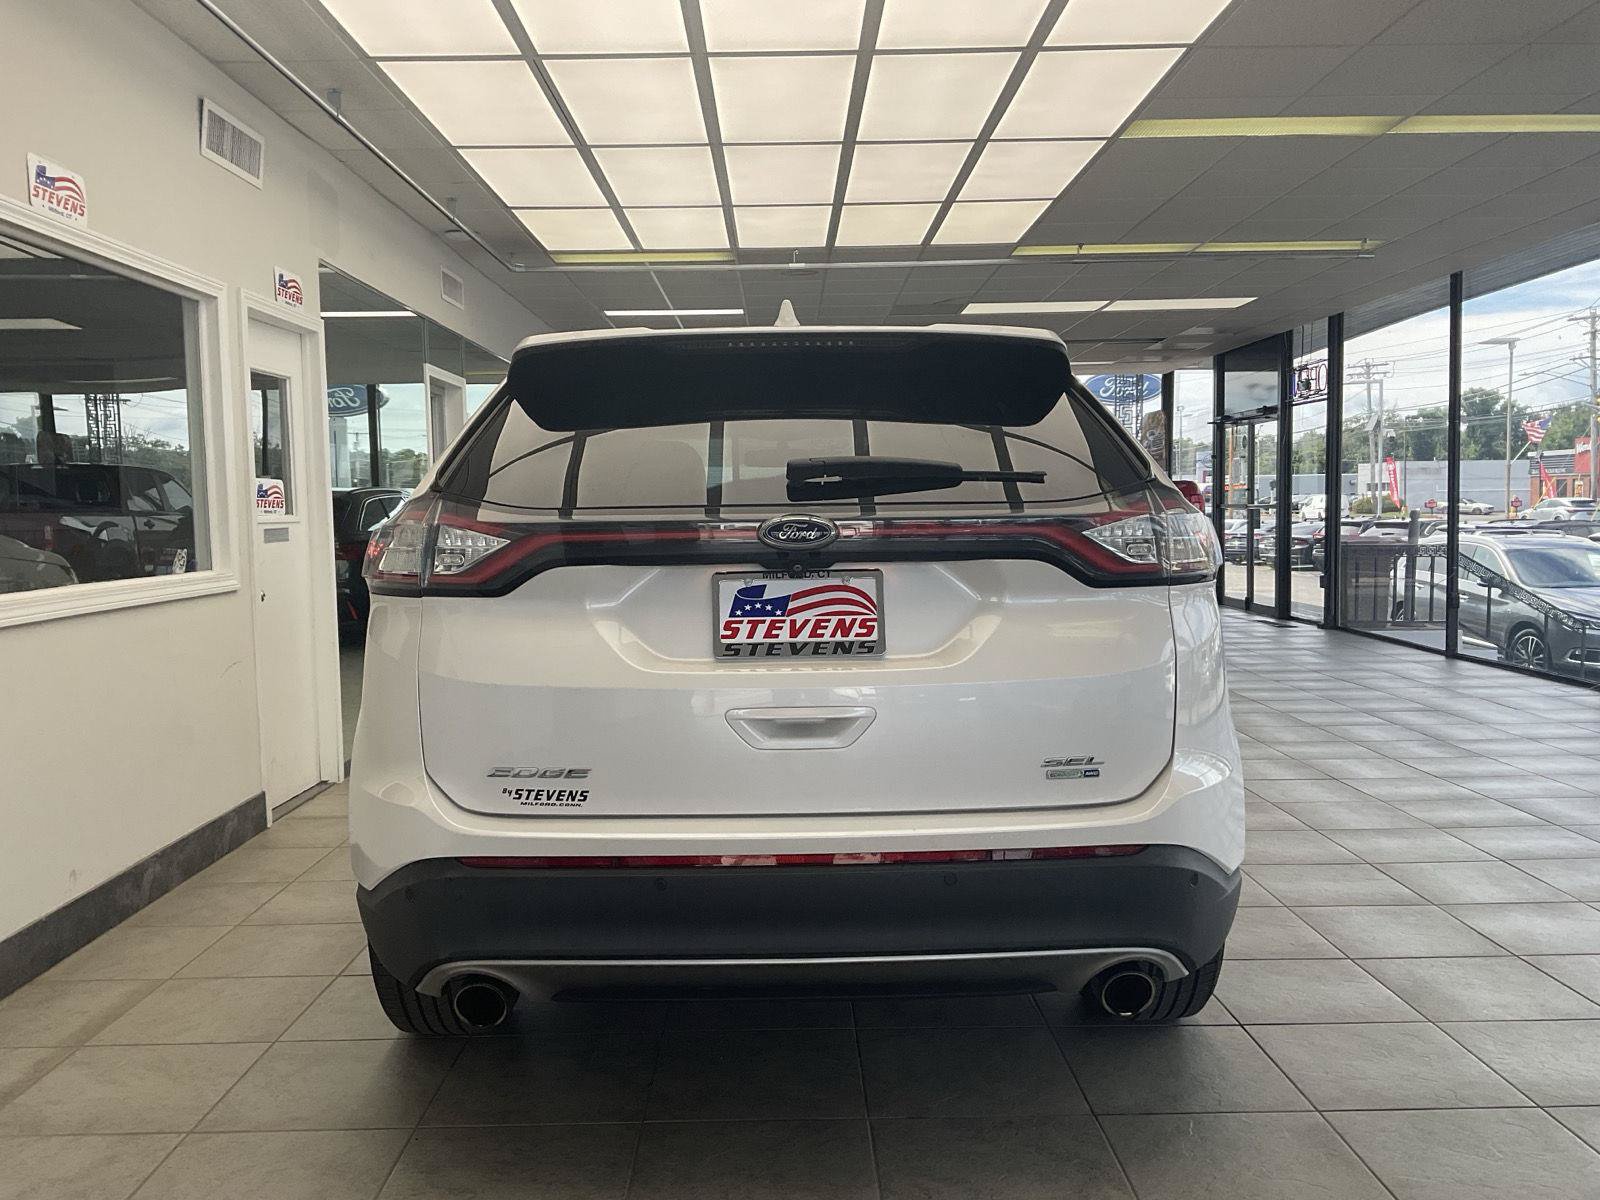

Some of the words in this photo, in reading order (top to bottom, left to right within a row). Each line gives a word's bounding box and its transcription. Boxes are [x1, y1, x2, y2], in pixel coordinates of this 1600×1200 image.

[32, 184, 86, 217] STEVENS
[277, 286, 304, 306] STEVENS
[1100, 376, 1150, 398] Ford
[256, 499, 284, 509] STEVENS
[779, 523, 818, 540] Ford
[720, 617, 878, 640] STEVENS
[723, 641, 877, 657] STEVENS
[1040, 756, 1105, 768] SEL
[486, 767, 593, 779] EDGE
[513, 788, 590, 802] STEVENS
